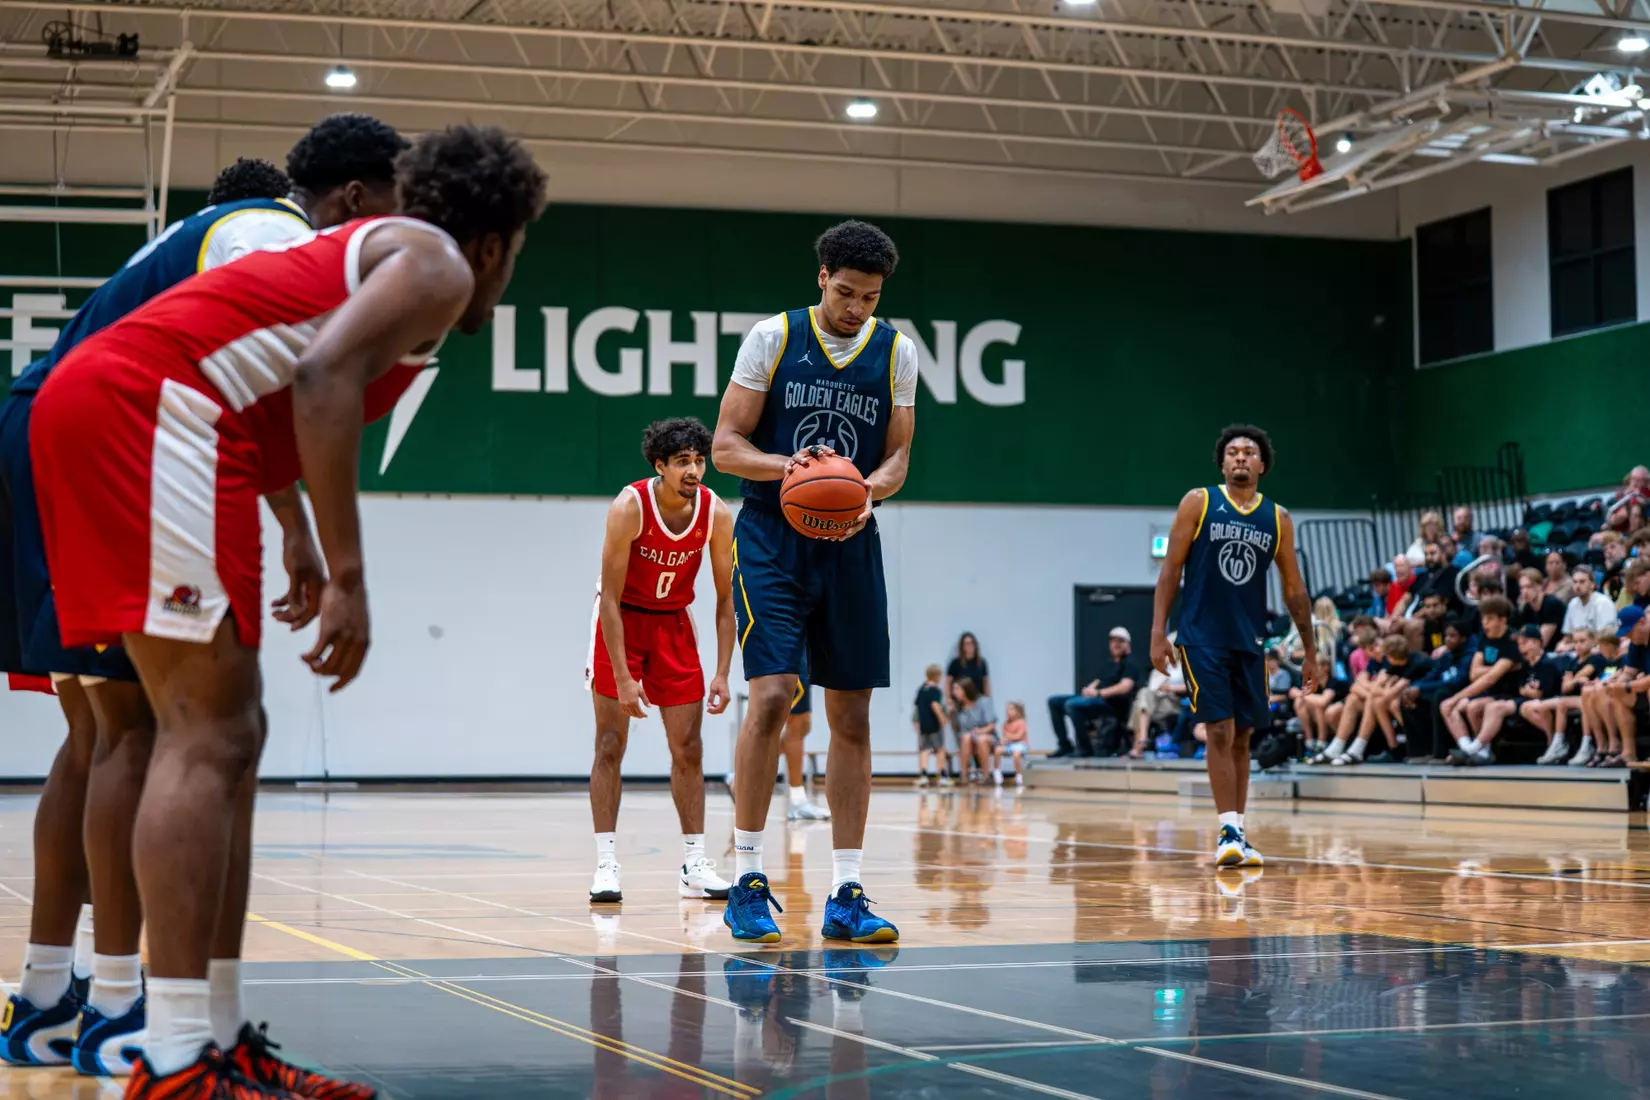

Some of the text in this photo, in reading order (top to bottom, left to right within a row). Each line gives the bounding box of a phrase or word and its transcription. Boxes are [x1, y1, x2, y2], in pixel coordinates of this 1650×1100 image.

[492, 304, 1026, 407] LIGHNG
[815, 379, 856, 392] MARQUETTE
[784, 381, 879, 426] GOLDEN EAGLES
[1209, 522, 1273, 553] GOLDEN EAGLES
[639, 545, 704, 566] CALGA
[1229, 557, 1245, 580] 10
[655, 571, 677, 600] 0
